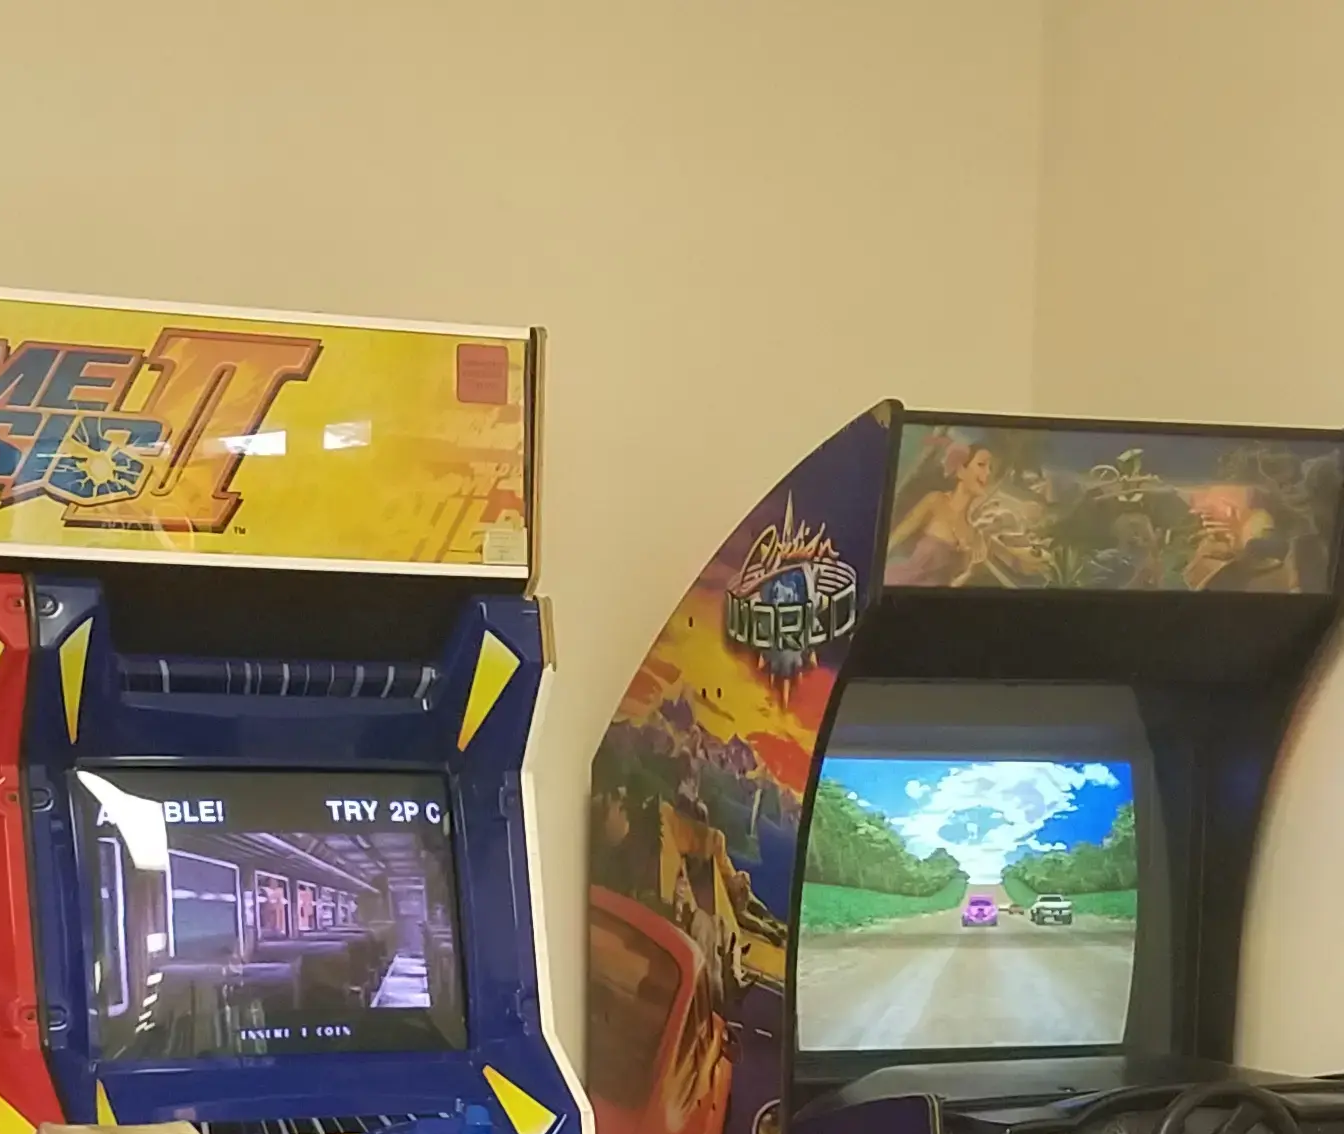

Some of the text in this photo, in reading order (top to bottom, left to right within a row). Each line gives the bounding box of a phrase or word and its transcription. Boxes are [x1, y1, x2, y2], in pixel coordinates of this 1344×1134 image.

[325, 800, 379, 822] TRY
[389, 803, 420, 822] 2P
[316, 1026, 351, 1037] COIN
